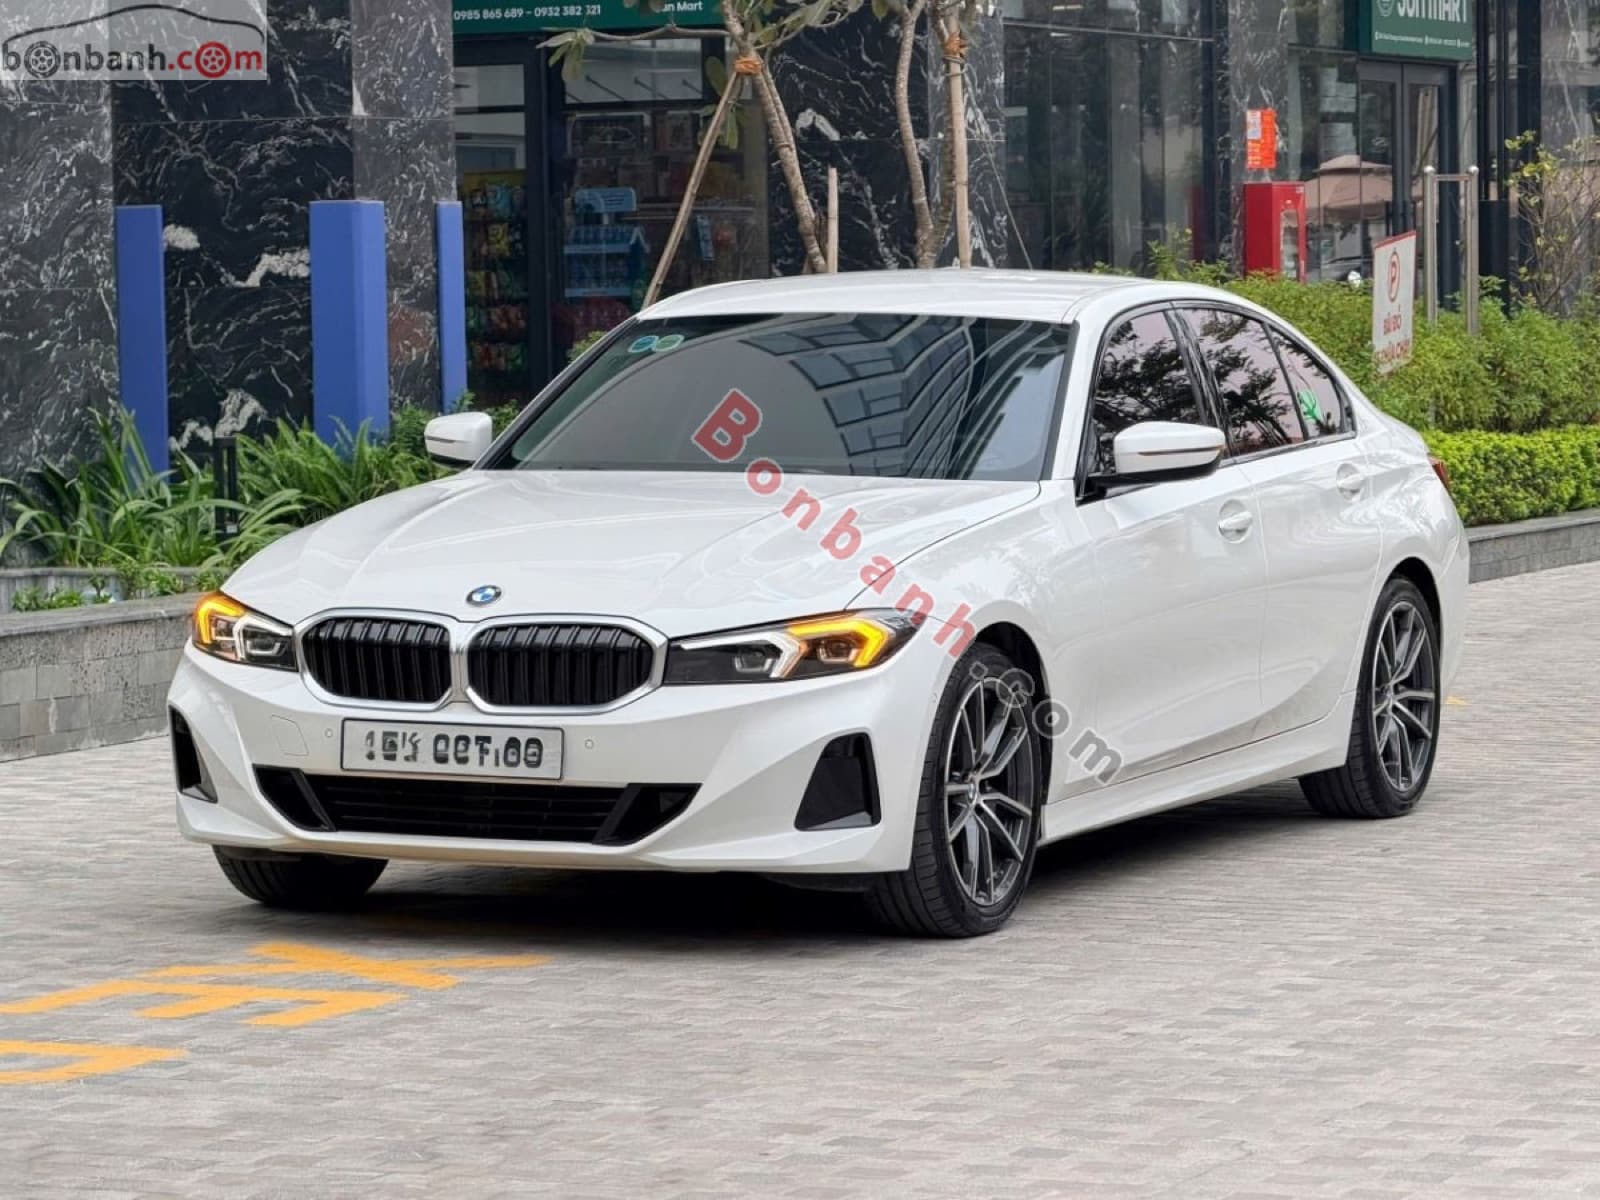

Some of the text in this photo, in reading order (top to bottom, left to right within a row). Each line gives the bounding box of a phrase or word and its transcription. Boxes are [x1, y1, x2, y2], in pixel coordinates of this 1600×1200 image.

[453, 9, 481, 21] 0985
[482, 8, 503, 20] 865
[504, 7, 524, 19] 689
[534, 6, 561, 17] 0932
[562, 5, 582, 16] 382
[676, 1, 704, 12] Mart
